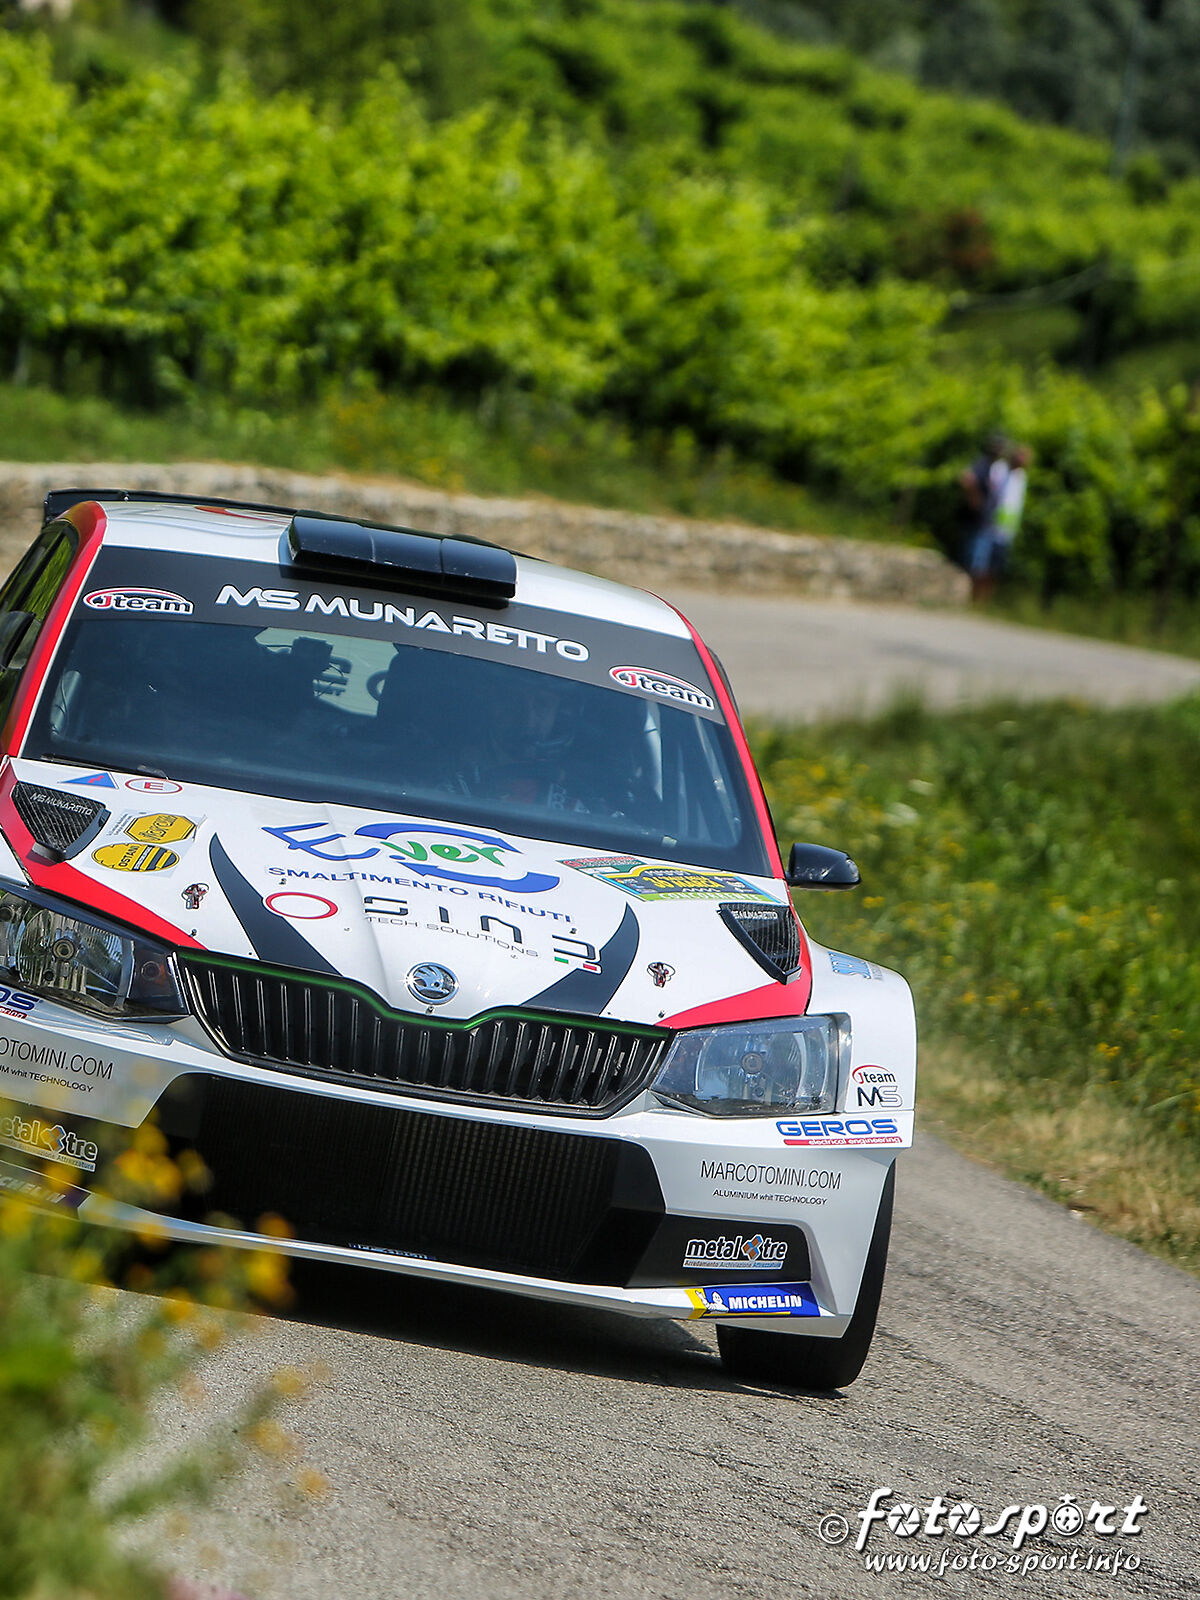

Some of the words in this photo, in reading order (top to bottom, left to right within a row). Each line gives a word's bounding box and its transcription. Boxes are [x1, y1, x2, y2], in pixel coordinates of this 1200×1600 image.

[215, 585, 300, 611] MS
[304, 594, 591, 663] MUNARETTO
[268, 866, 469, 896] SMALTIMENTO
[478, 892, 571, 923] RIFIUTI
[365, 916, 418, 928] TECH
[426, 923, 539, 957] SOLUTIONS
[10, 1068, 28, 1079] whit
[29, 1071, 94, 1094] TECHNOLOGY
[856, 1086, 903, 1107] MS
[776, 1119, 898, 1136] GEROS
[65, 1131, 98, 1162] tre
[848, 1138, 901, 1147] engineering
[701, 1161, 842, 1190] MARCOTOMINI.COM
[713, 1189, 758, 1200] ALUMINIUM
[774, 1195, 828, 1206] TECHNOLOGY
[684, 1235, 742, 1260] metal
[761, 1237, 788, 1260] tre
[728, 1294, 803, 1311] MICHELIN
